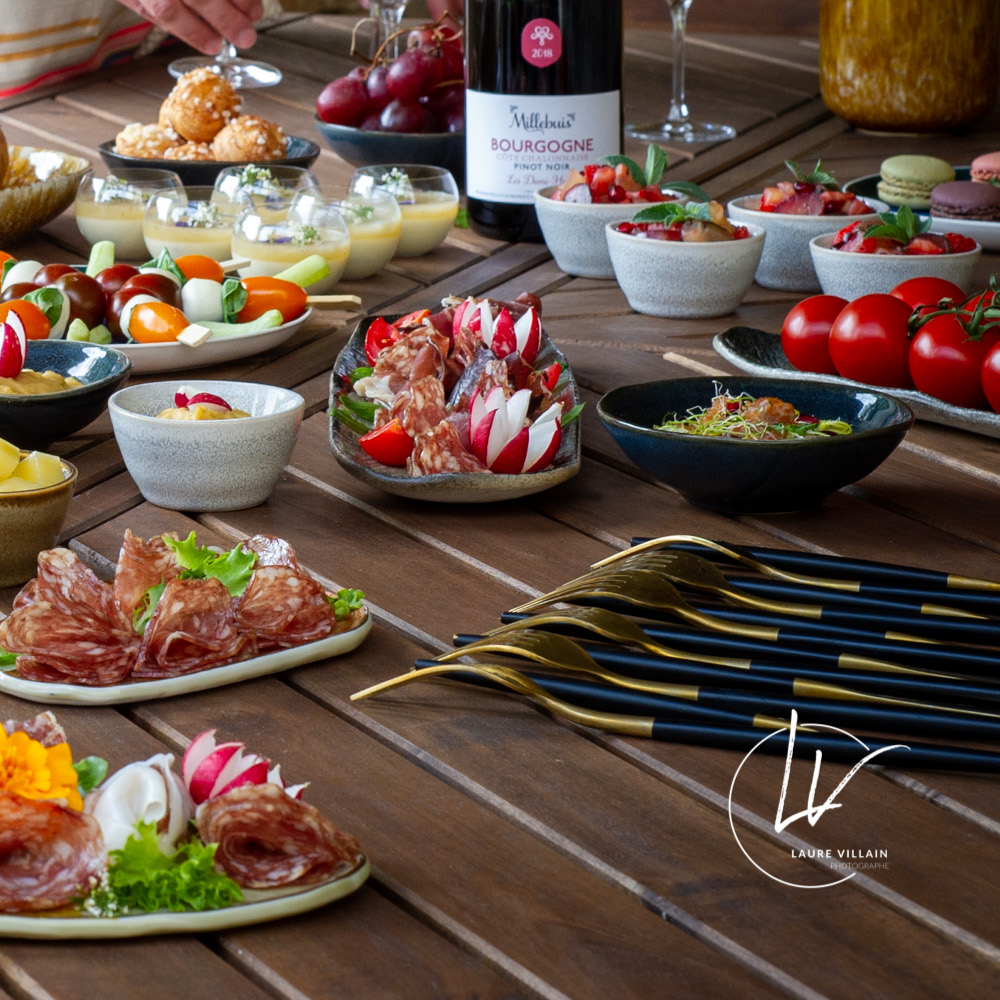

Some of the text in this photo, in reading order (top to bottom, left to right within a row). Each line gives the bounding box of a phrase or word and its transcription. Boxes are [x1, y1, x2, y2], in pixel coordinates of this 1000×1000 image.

[531, 48, 553, 58] 2018
[509, 112, 572, 134] Millebuis
[491, 137, 594, 153] BOURGOGNE
